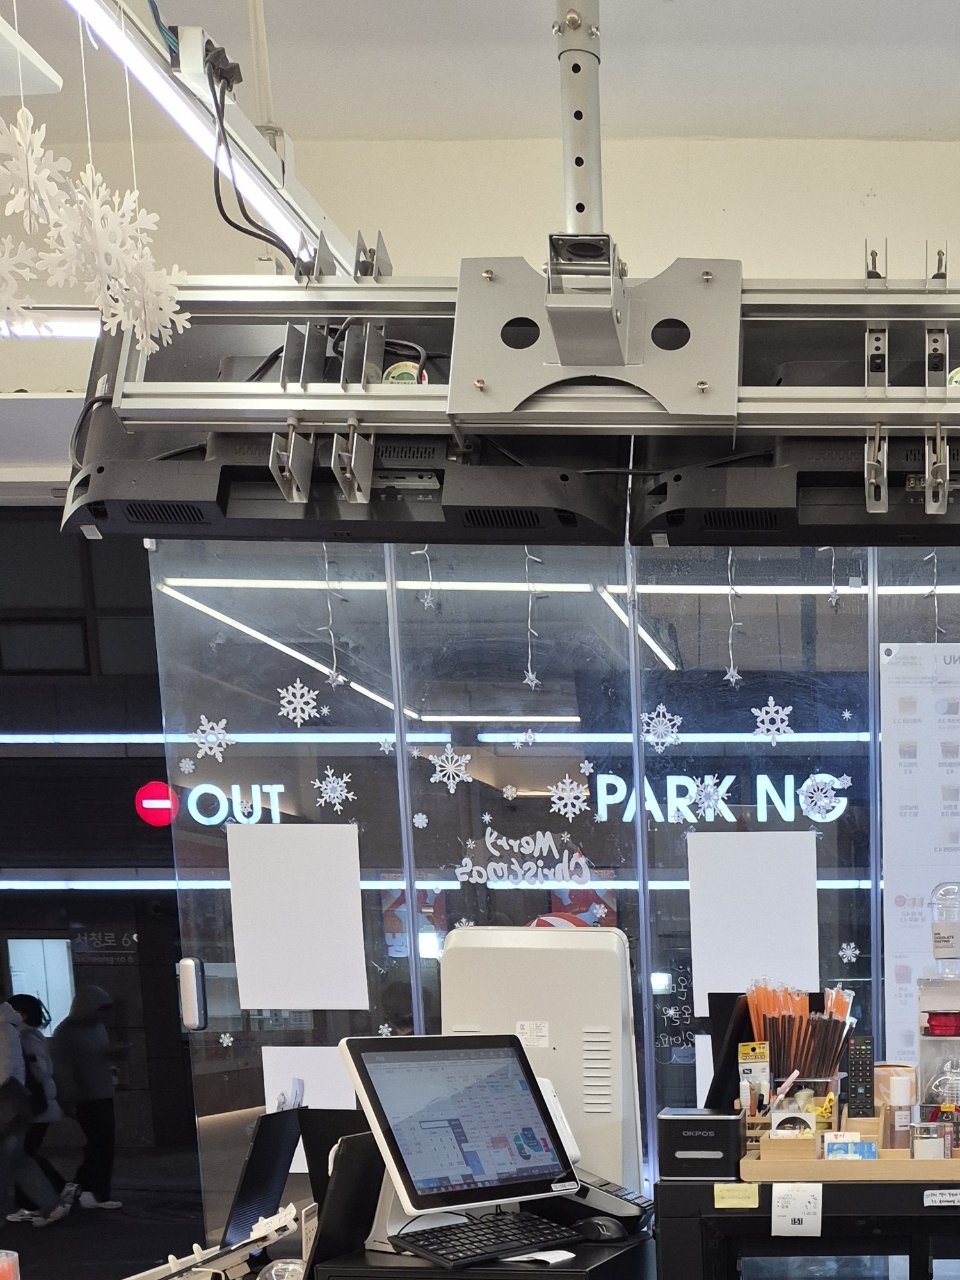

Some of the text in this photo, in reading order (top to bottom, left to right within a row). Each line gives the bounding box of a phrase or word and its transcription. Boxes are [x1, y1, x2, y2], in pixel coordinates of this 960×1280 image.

[187, 783, 285, 826] OUT
[596, 773, 848, 823] PARKNG
[121, 932, 131, 947] 6
[128, 954, 134, 963] 6
